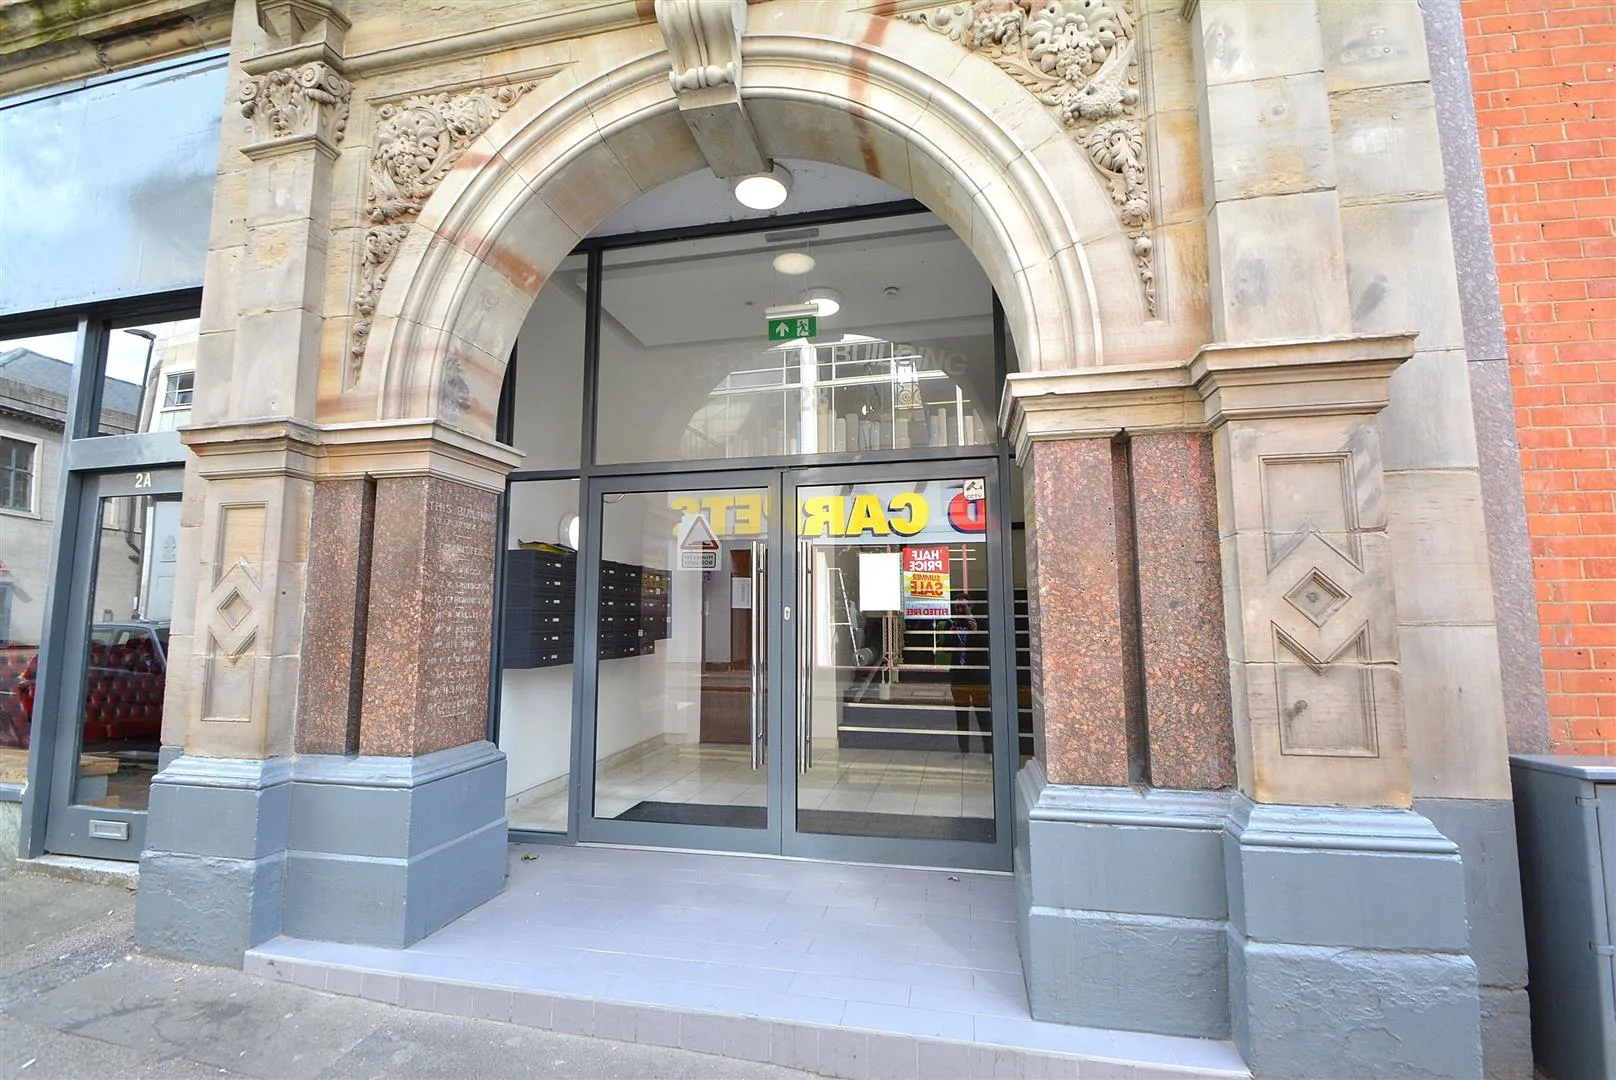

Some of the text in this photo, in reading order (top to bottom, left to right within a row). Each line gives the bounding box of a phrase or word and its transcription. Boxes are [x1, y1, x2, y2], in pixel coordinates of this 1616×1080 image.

[836, 342, 968, 376] BUILDING
[135, 472, 151, 488] 2A
[428, 500, 452, 513] THIS
